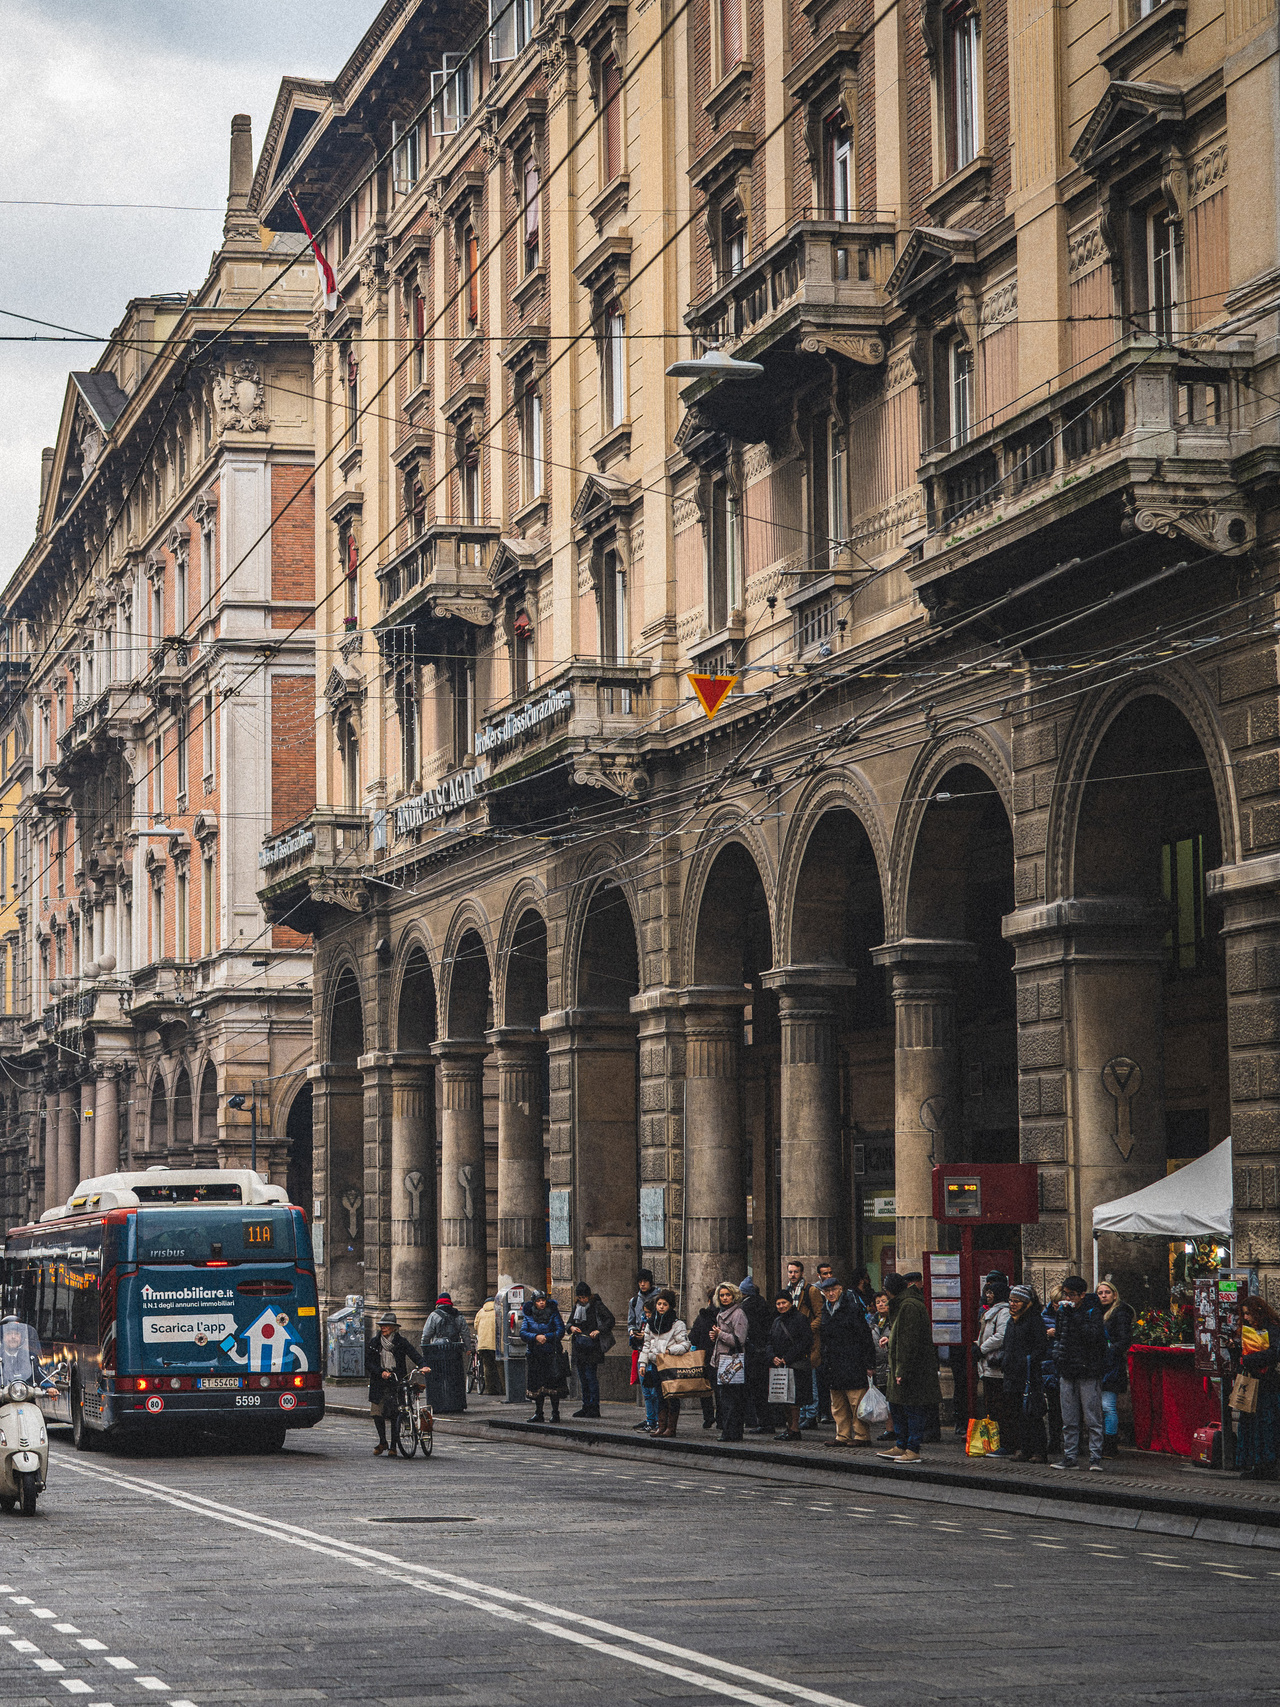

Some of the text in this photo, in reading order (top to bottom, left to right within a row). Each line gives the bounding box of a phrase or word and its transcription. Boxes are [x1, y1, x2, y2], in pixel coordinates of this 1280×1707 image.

[475, 726, 503, 757] brokers
[513, 690, 571, 736] assicurazione
[396, 789, 437, 836] ANDREA
[248, 1226, 271, 1242] 11A
[150, 1248, 185, 1258] irisbus
[158, 1301, 175, 1309] degli
[200, 1300, 235, 1308] immobiliari
[150, 1322, 226, 1335] Scarica l'app
[150, 1400, 160, 1409] 80
[235, 1395, 261, 1406] 5599
[282, 1396, 294, 1405] 100
